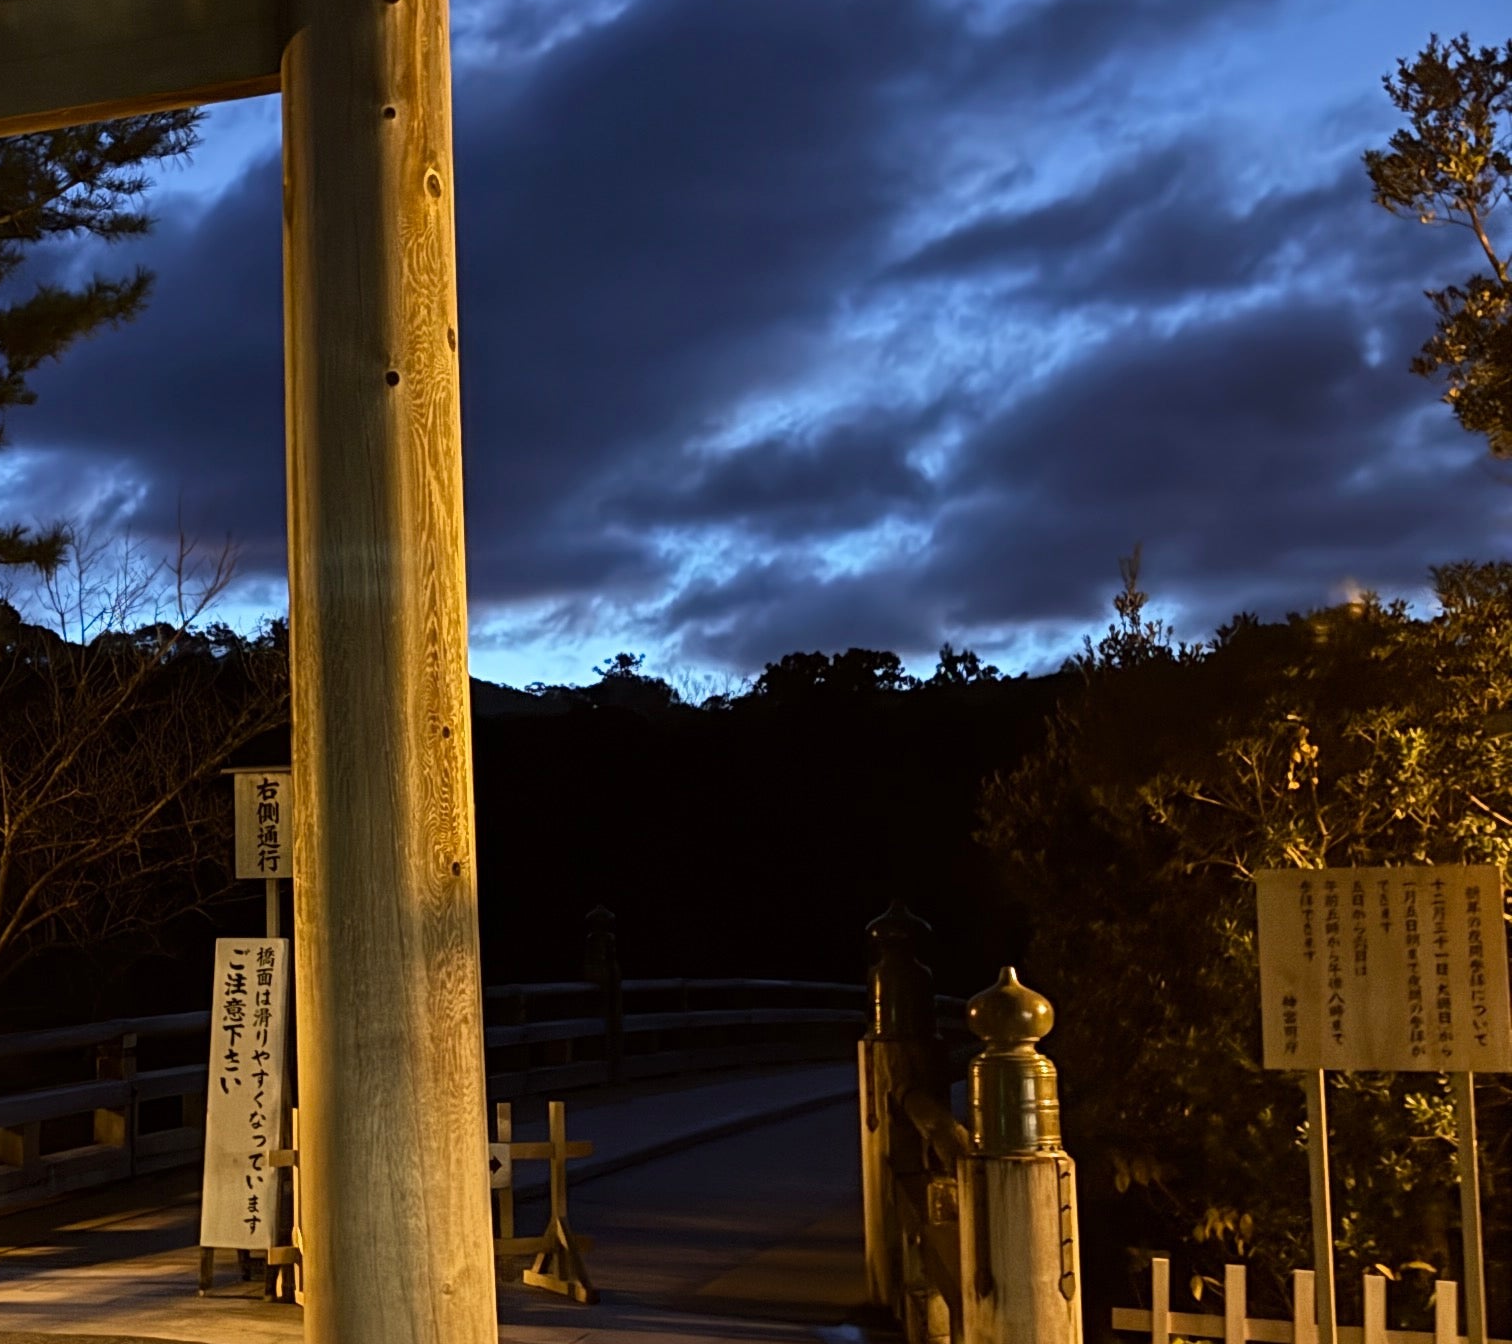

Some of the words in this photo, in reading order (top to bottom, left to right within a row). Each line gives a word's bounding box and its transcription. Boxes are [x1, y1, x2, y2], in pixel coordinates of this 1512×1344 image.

[256, 777, 281, 873] 右側通行
[1377, 879, 1392, 935] できます
[220, 948, 250, 1094] ご注意下さい
[244, 946, 275, 1235] 橋面は滑りやすくなっています
